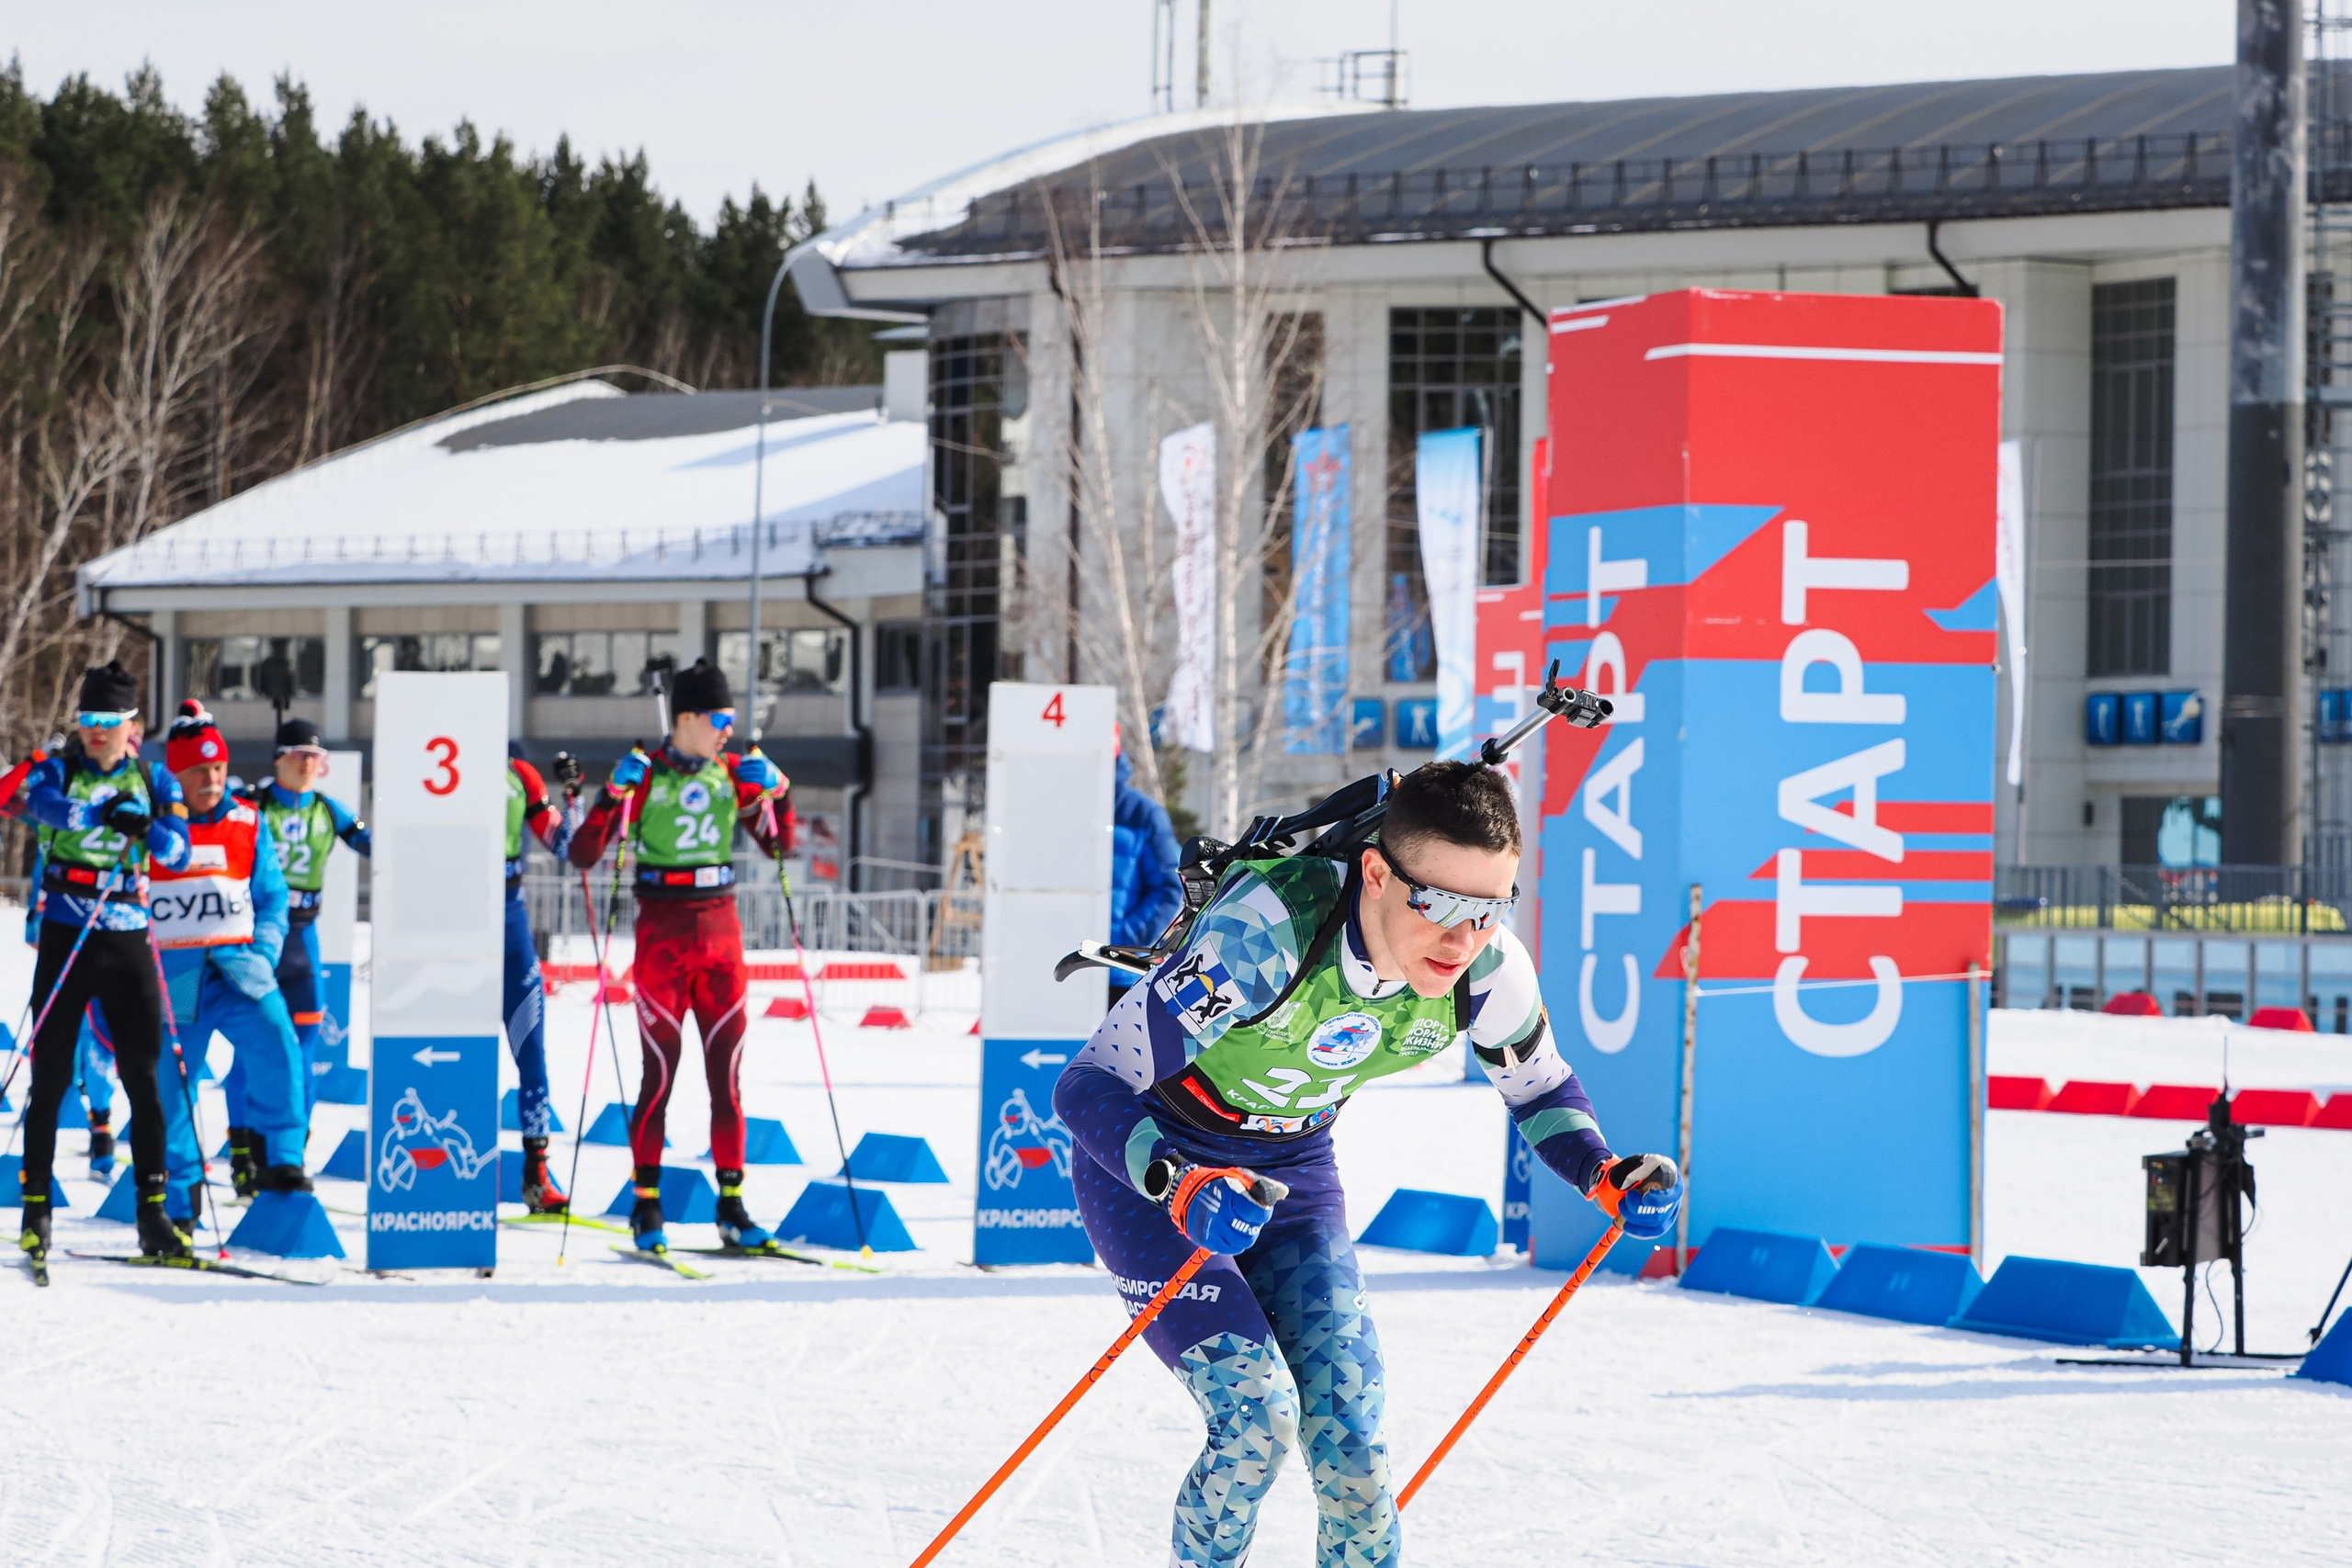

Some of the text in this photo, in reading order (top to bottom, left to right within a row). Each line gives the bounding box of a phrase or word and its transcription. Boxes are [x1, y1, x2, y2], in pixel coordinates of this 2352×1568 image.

[1043, 693, 1066, 728] 4
[424, 737, 459, 795] 3
[1579, 526, 1646, 1054] СТАРТ
[1774, 520, 1909, 1057] СТАРТ
[674, 813, 721, 851] 24
[1402, 1035, 1445, 1049] ЖИЗНИ
[371, 1212, 495, 1232] КРАСНОЯРСК
[978, 1208, 1083, 1228] КРАСНОЯРС
[1110, 1272, 1221, 1303] ИБИРСАЯ
